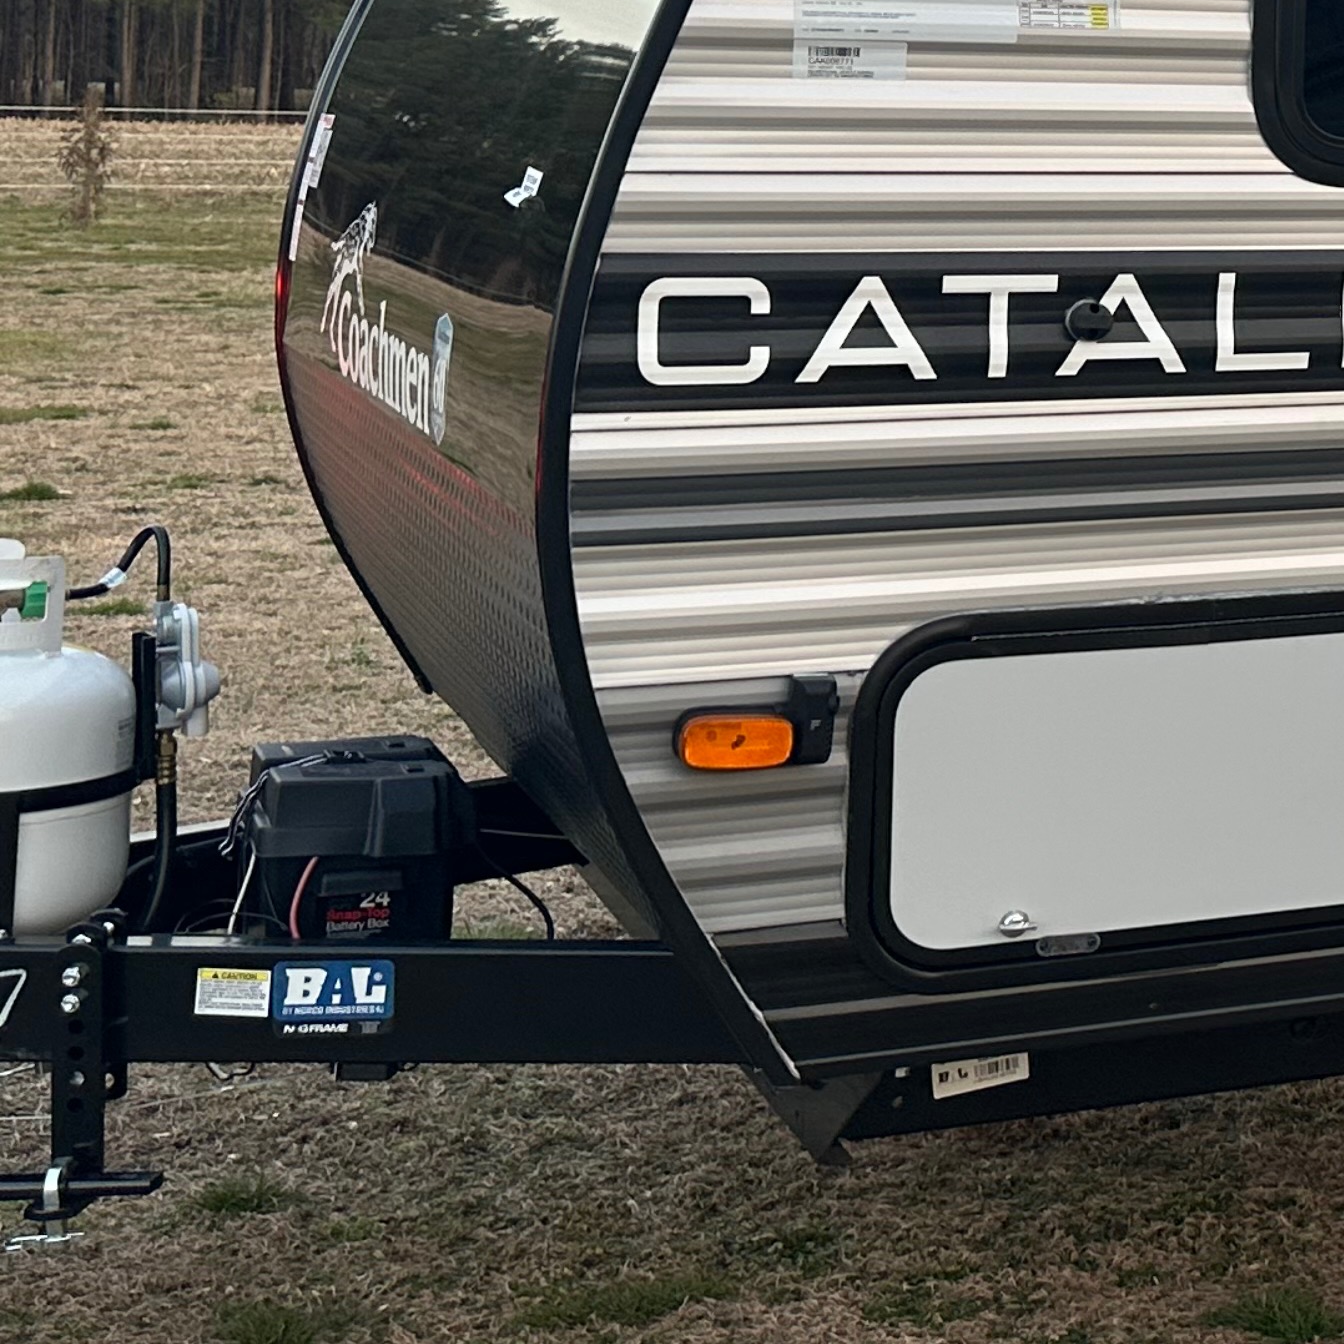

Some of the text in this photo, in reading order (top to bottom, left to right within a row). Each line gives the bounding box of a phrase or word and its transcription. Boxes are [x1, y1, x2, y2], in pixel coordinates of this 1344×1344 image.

[337, 290, 430, 436] Coachmen
[360, 891, 391, 908] 24
[366, 917, 390, 929] Box
[221, 971, 258, 981] CAUTION
[283, 967, 387, 1006] BAL
